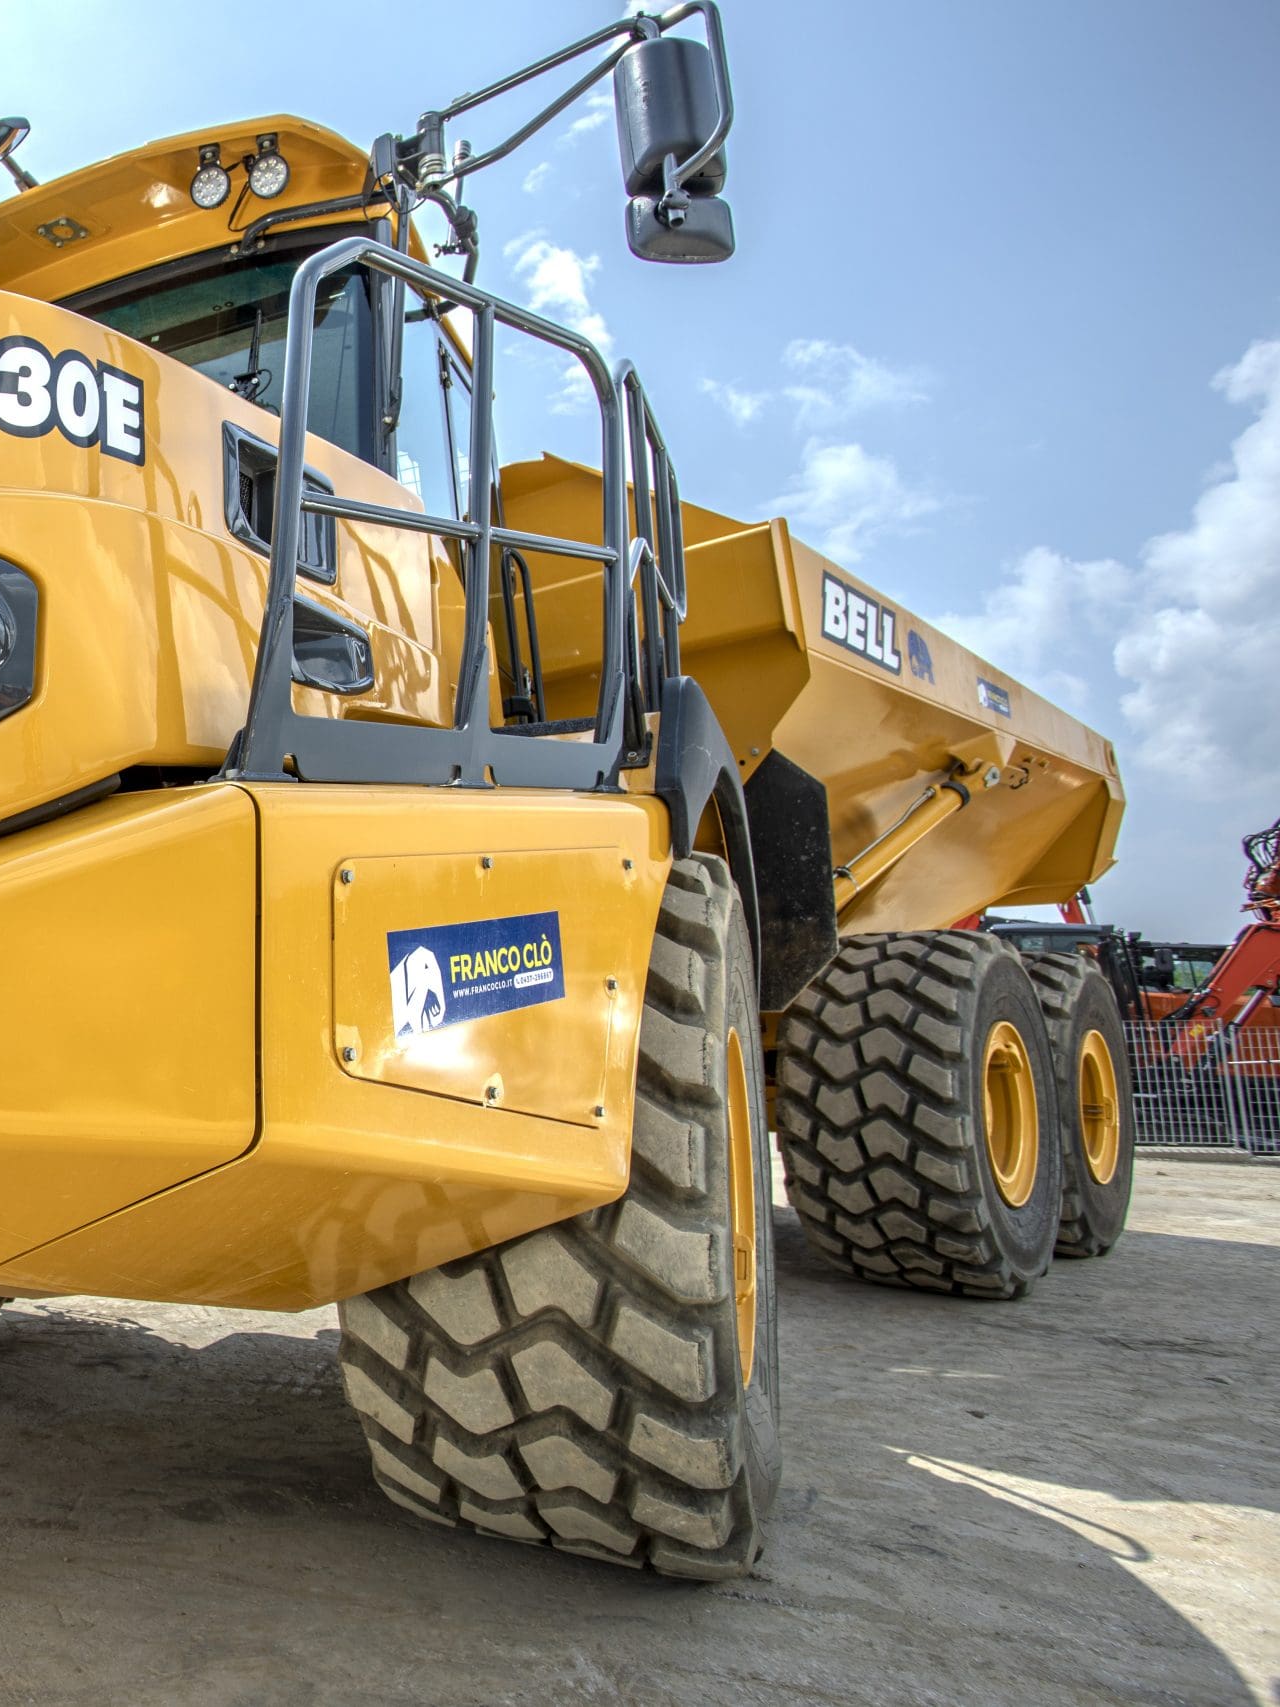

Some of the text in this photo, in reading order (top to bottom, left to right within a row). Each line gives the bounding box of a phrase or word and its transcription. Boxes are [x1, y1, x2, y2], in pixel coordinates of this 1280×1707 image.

[823, 577, 899, 670] BELL
[449, 933, 552, 984] FRANCO CLÒ
[452, 978, 513, 999] WWW.FRANCOCLO.IT
